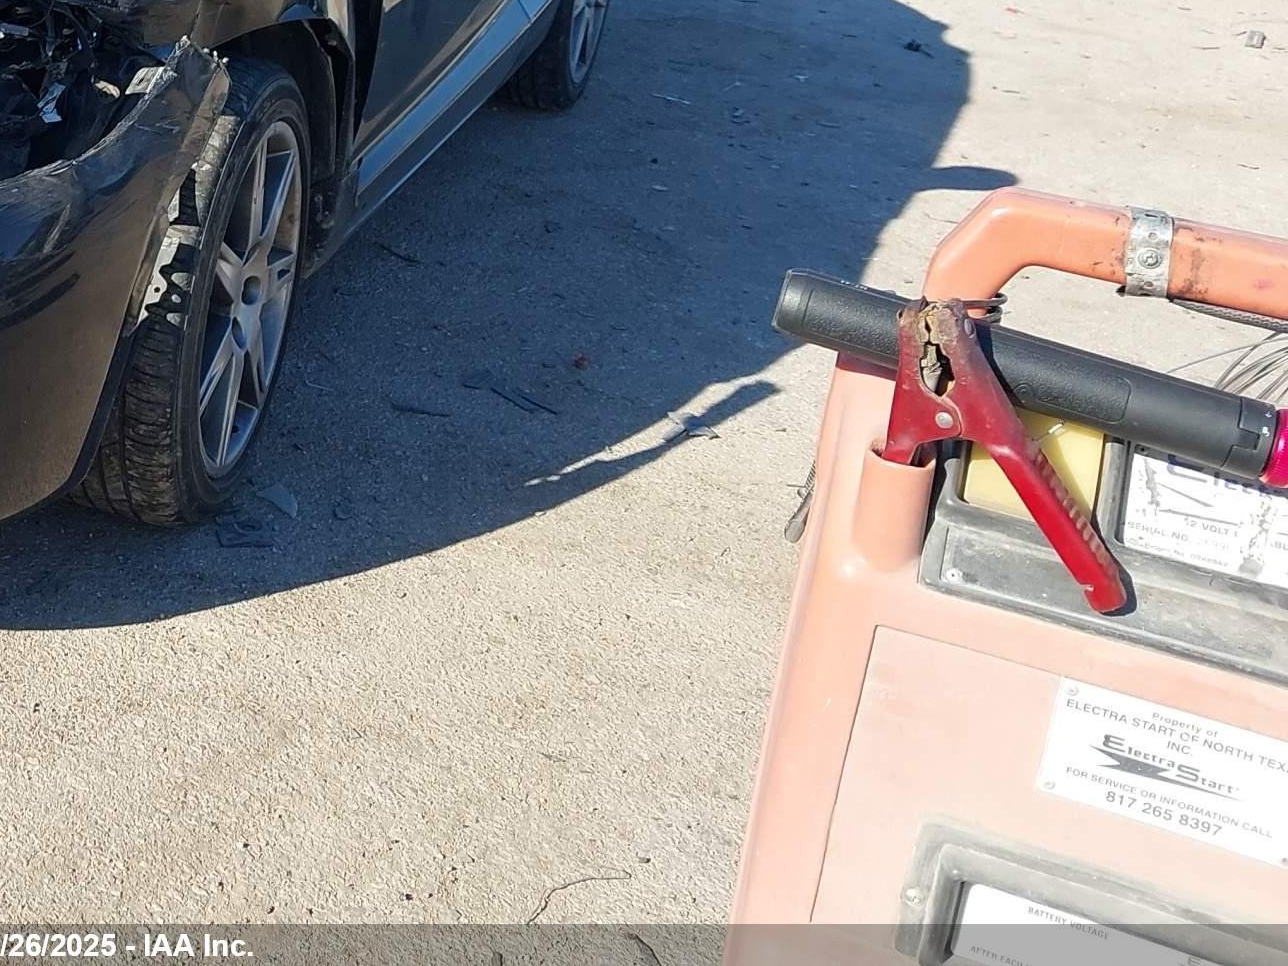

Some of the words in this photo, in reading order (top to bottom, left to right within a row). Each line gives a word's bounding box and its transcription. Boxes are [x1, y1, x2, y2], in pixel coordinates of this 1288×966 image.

[1127, 520, 1167, 537] SERIAL
[1201, 521, 1230, 536] VOLT
[1065, 697, 1128, 724] ELECTRA
[1131, 716, 1177, 738] START
[1179, 731, 1200, 745] OF
[1202, 737, 1254, 762] NORTH
[1258, 754, 1288, 774] TEX
[1151, 711, 1203, 734] Property
[1205, 728, 1219, 738] of
[1166, 740, 1194, 757] INC.
[1065, 766, 1089, 779] FOR
[1091, 773, 1138, 795] SERVICE
[1139, 788, 1157, 800] OR
[1159, 794, 1239, 827] INFORMATION
[1241, 821, 1273, 839] CALL
[1105, 790, 1138, 809] 817
[1141, 802, 1174, 821] 265
[1178, 813, 1223, 836] 8397
[1028, 906, 1067, 925] BATTERY
[1070, 920, 1109, 940] VOLTAGE
[970, 945, 998, 961] AFTER
